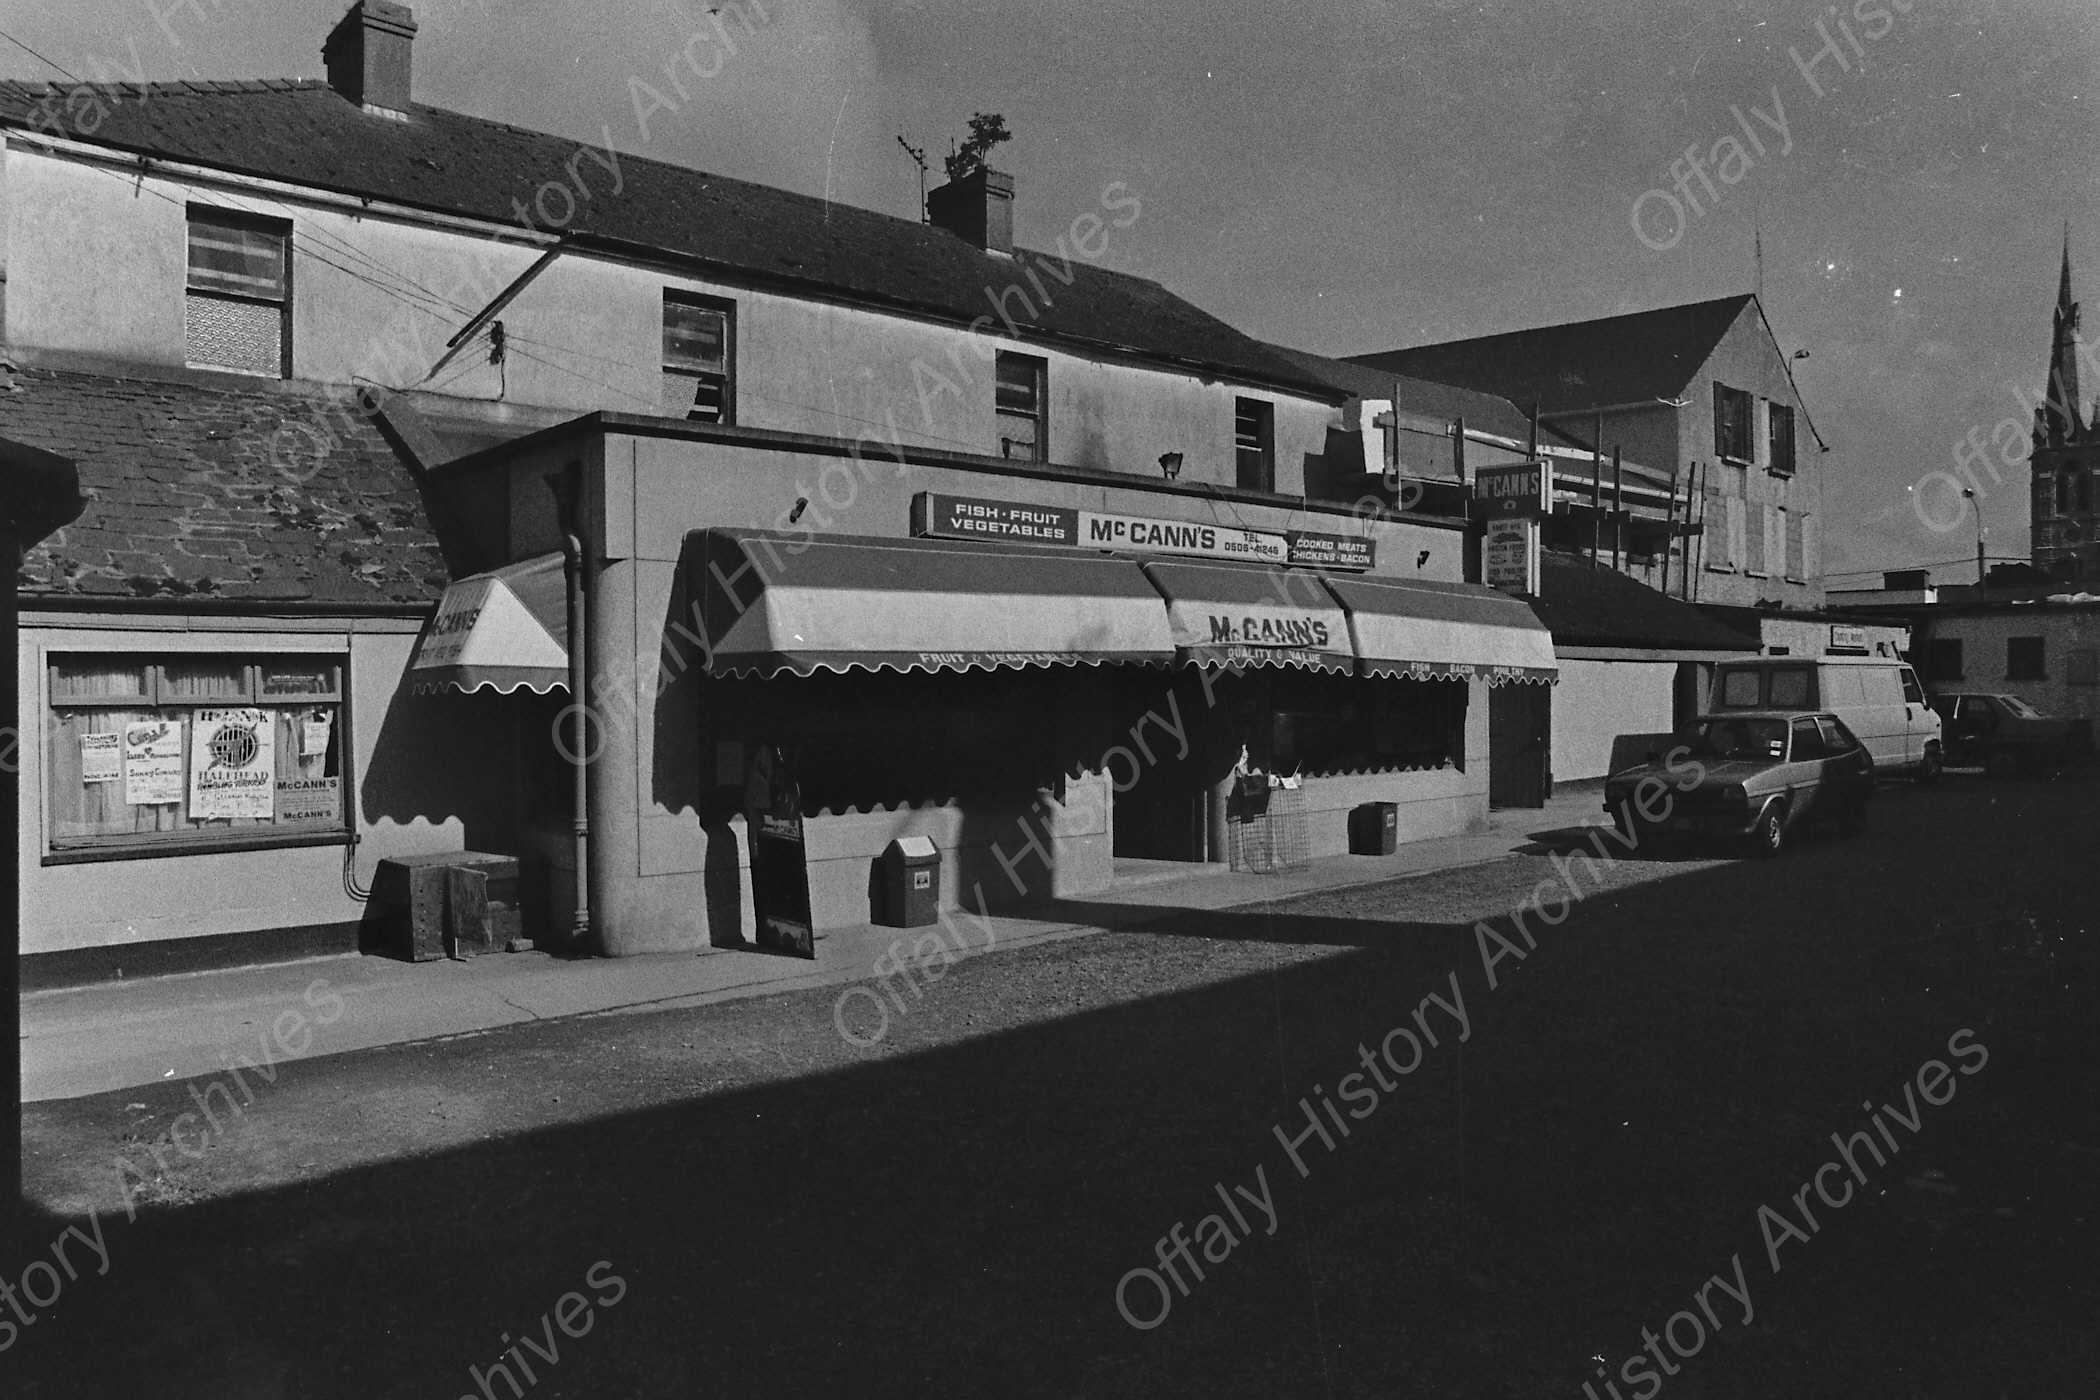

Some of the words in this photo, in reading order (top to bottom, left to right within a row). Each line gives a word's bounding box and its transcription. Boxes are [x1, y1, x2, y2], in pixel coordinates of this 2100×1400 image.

[955, 504, 998, 518] FISH
[1010, 510, 1060, 525] FRUIT
[950, 517, 1065, 539] VEGETABLES
[1296, 539, 1333, 549] COOKED
[1338, 542, 1367, 553] MEATS
[919, 653, 965, 663] FRUIT
[1228, 647, 1272, 659] QUALITY
[1288, 650, 1321, 663] VALUE
